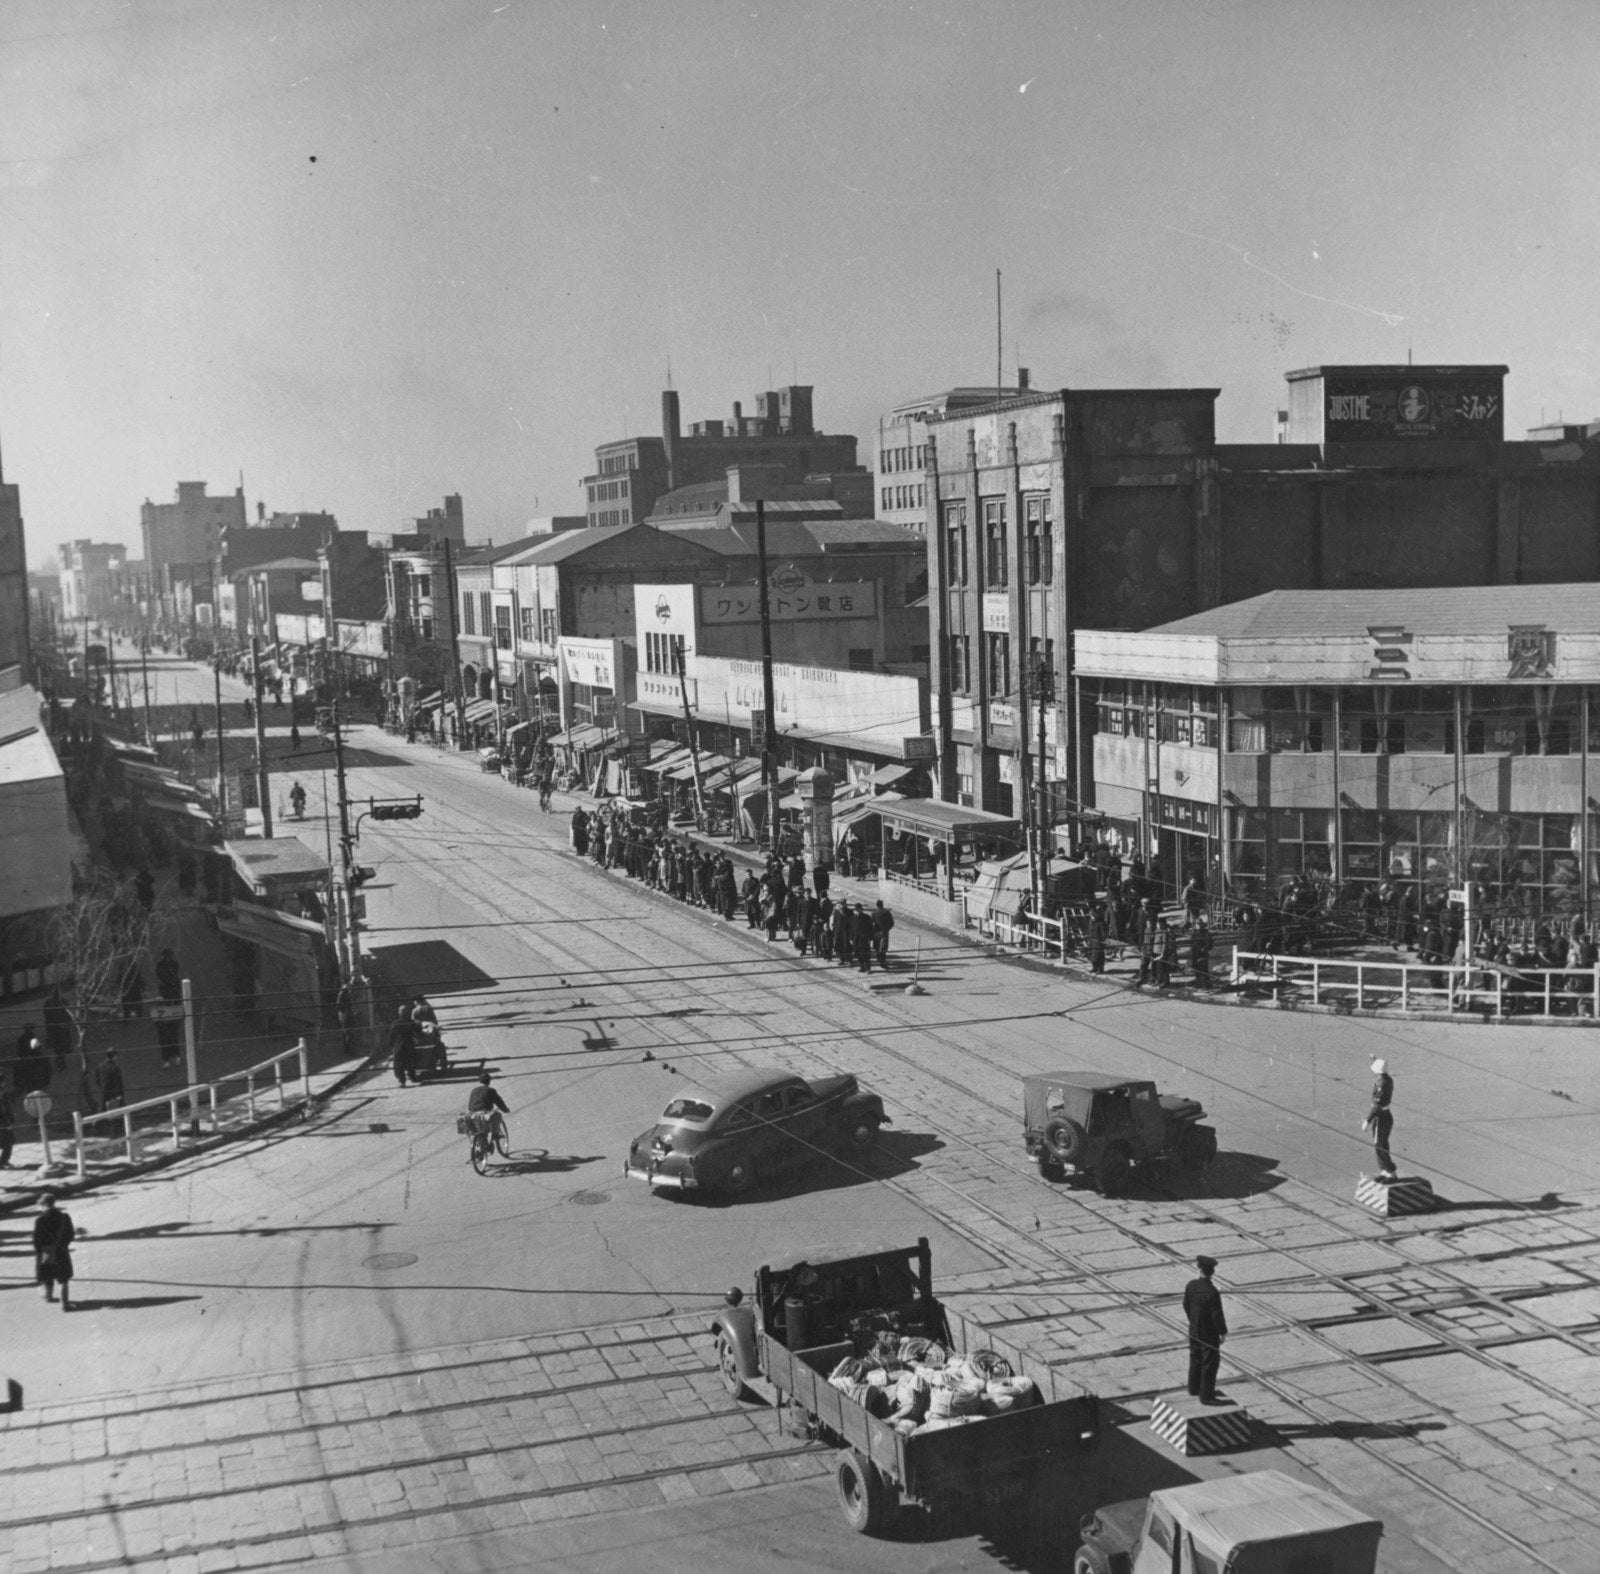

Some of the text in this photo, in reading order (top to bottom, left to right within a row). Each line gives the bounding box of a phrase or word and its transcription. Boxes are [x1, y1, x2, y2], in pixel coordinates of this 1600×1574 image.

[717, 595, 854, 617] ワシトン靴店
